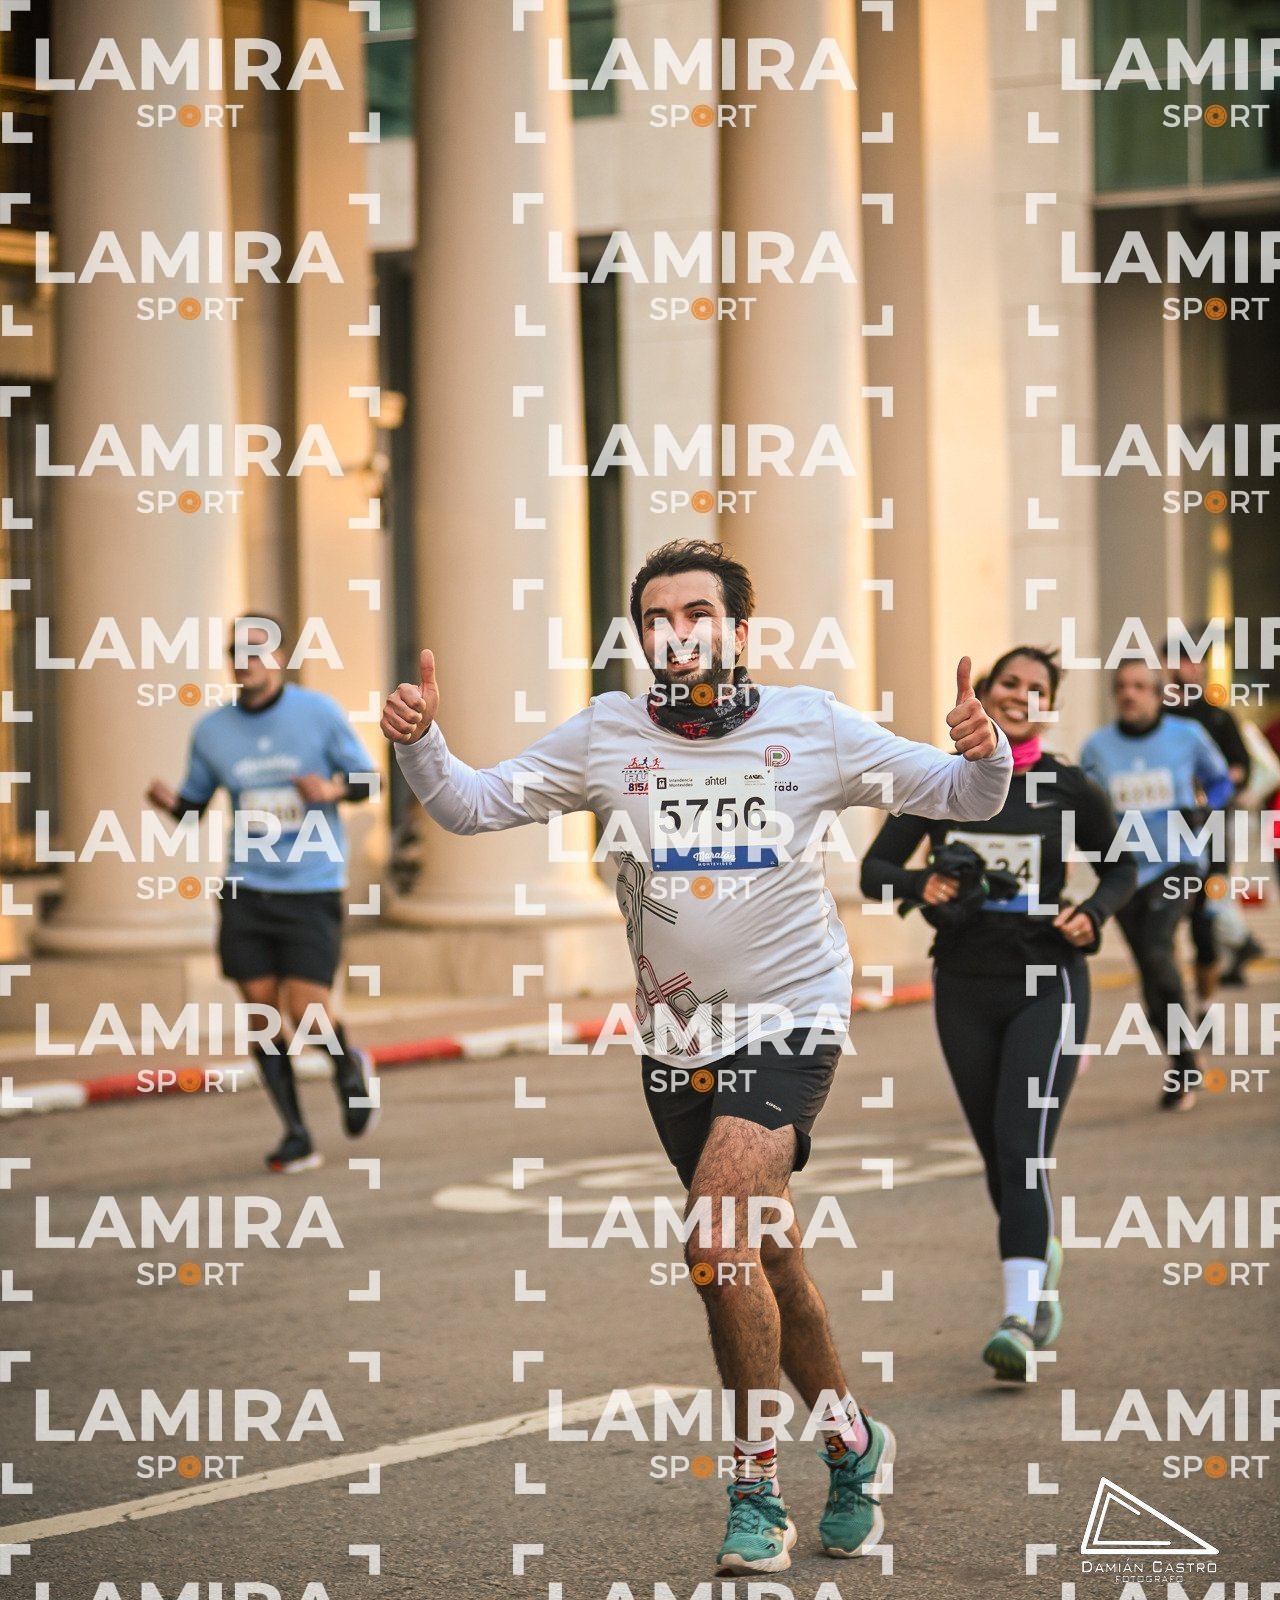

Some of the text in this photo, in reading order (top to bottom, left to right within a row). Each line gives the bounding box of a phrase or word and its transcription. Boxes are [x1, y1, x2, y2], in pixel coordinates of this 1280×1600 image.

[625, 773, 648, 782] RU
[704, 776, 728, 786] antel
[774, 781, 799, 792] rado
[658, 796, 767, 834] 5756
[994, 857, 1032, 882] 24
